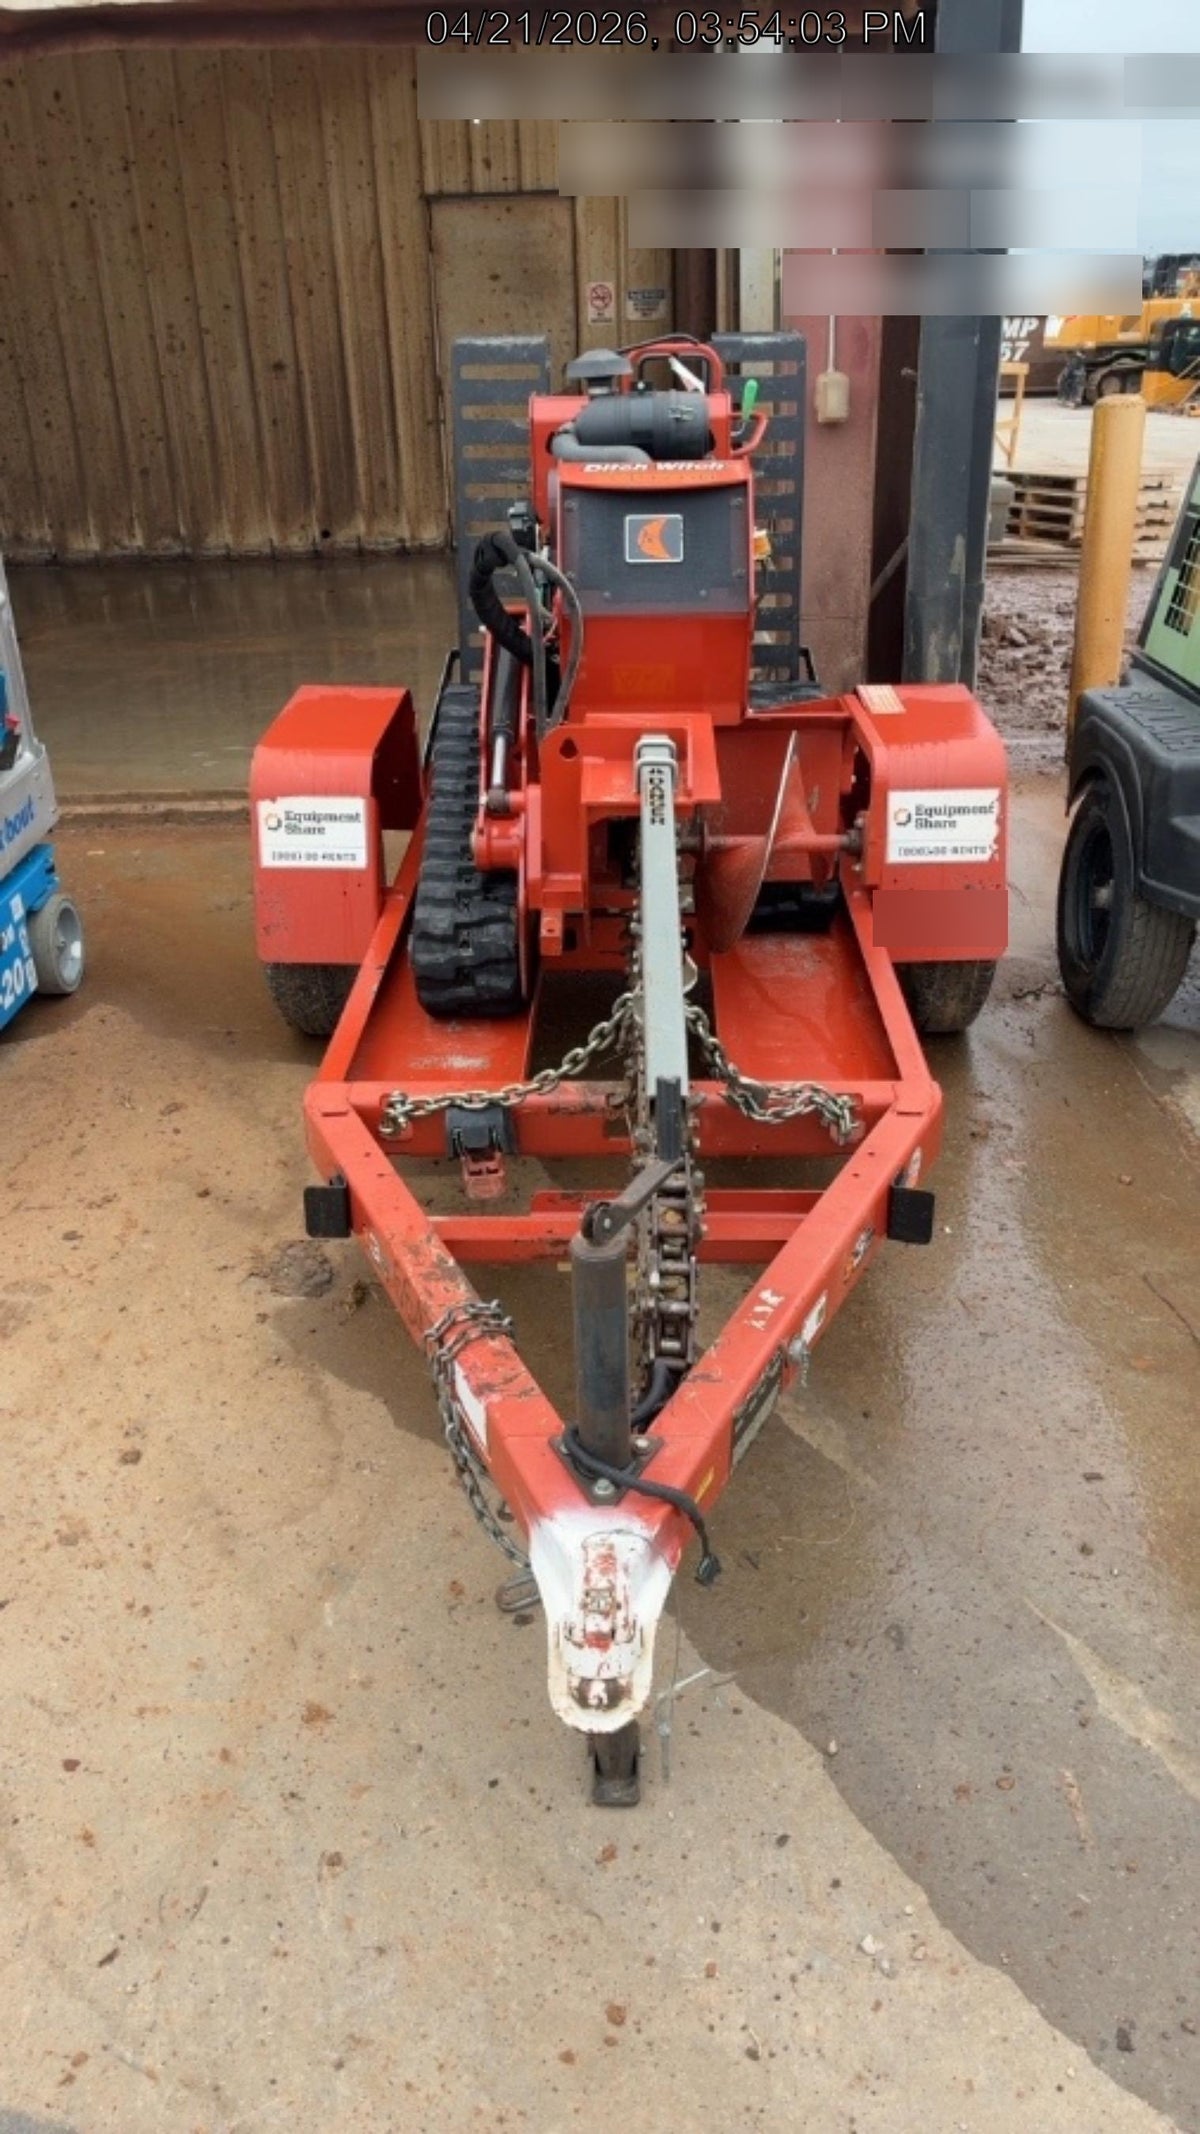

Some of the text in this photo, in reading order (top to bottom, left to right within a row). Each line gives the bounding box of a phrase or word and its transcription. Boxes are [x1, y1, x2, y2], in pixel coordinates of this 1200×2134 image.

[583, 460, 725, 473] Ditch Witch
[914, 801, 995, 819] Equipment
[283, 810, 362, 824] Equipment
[914, 817, 957, 830] Share
[284, 823, 326, 836] Share
